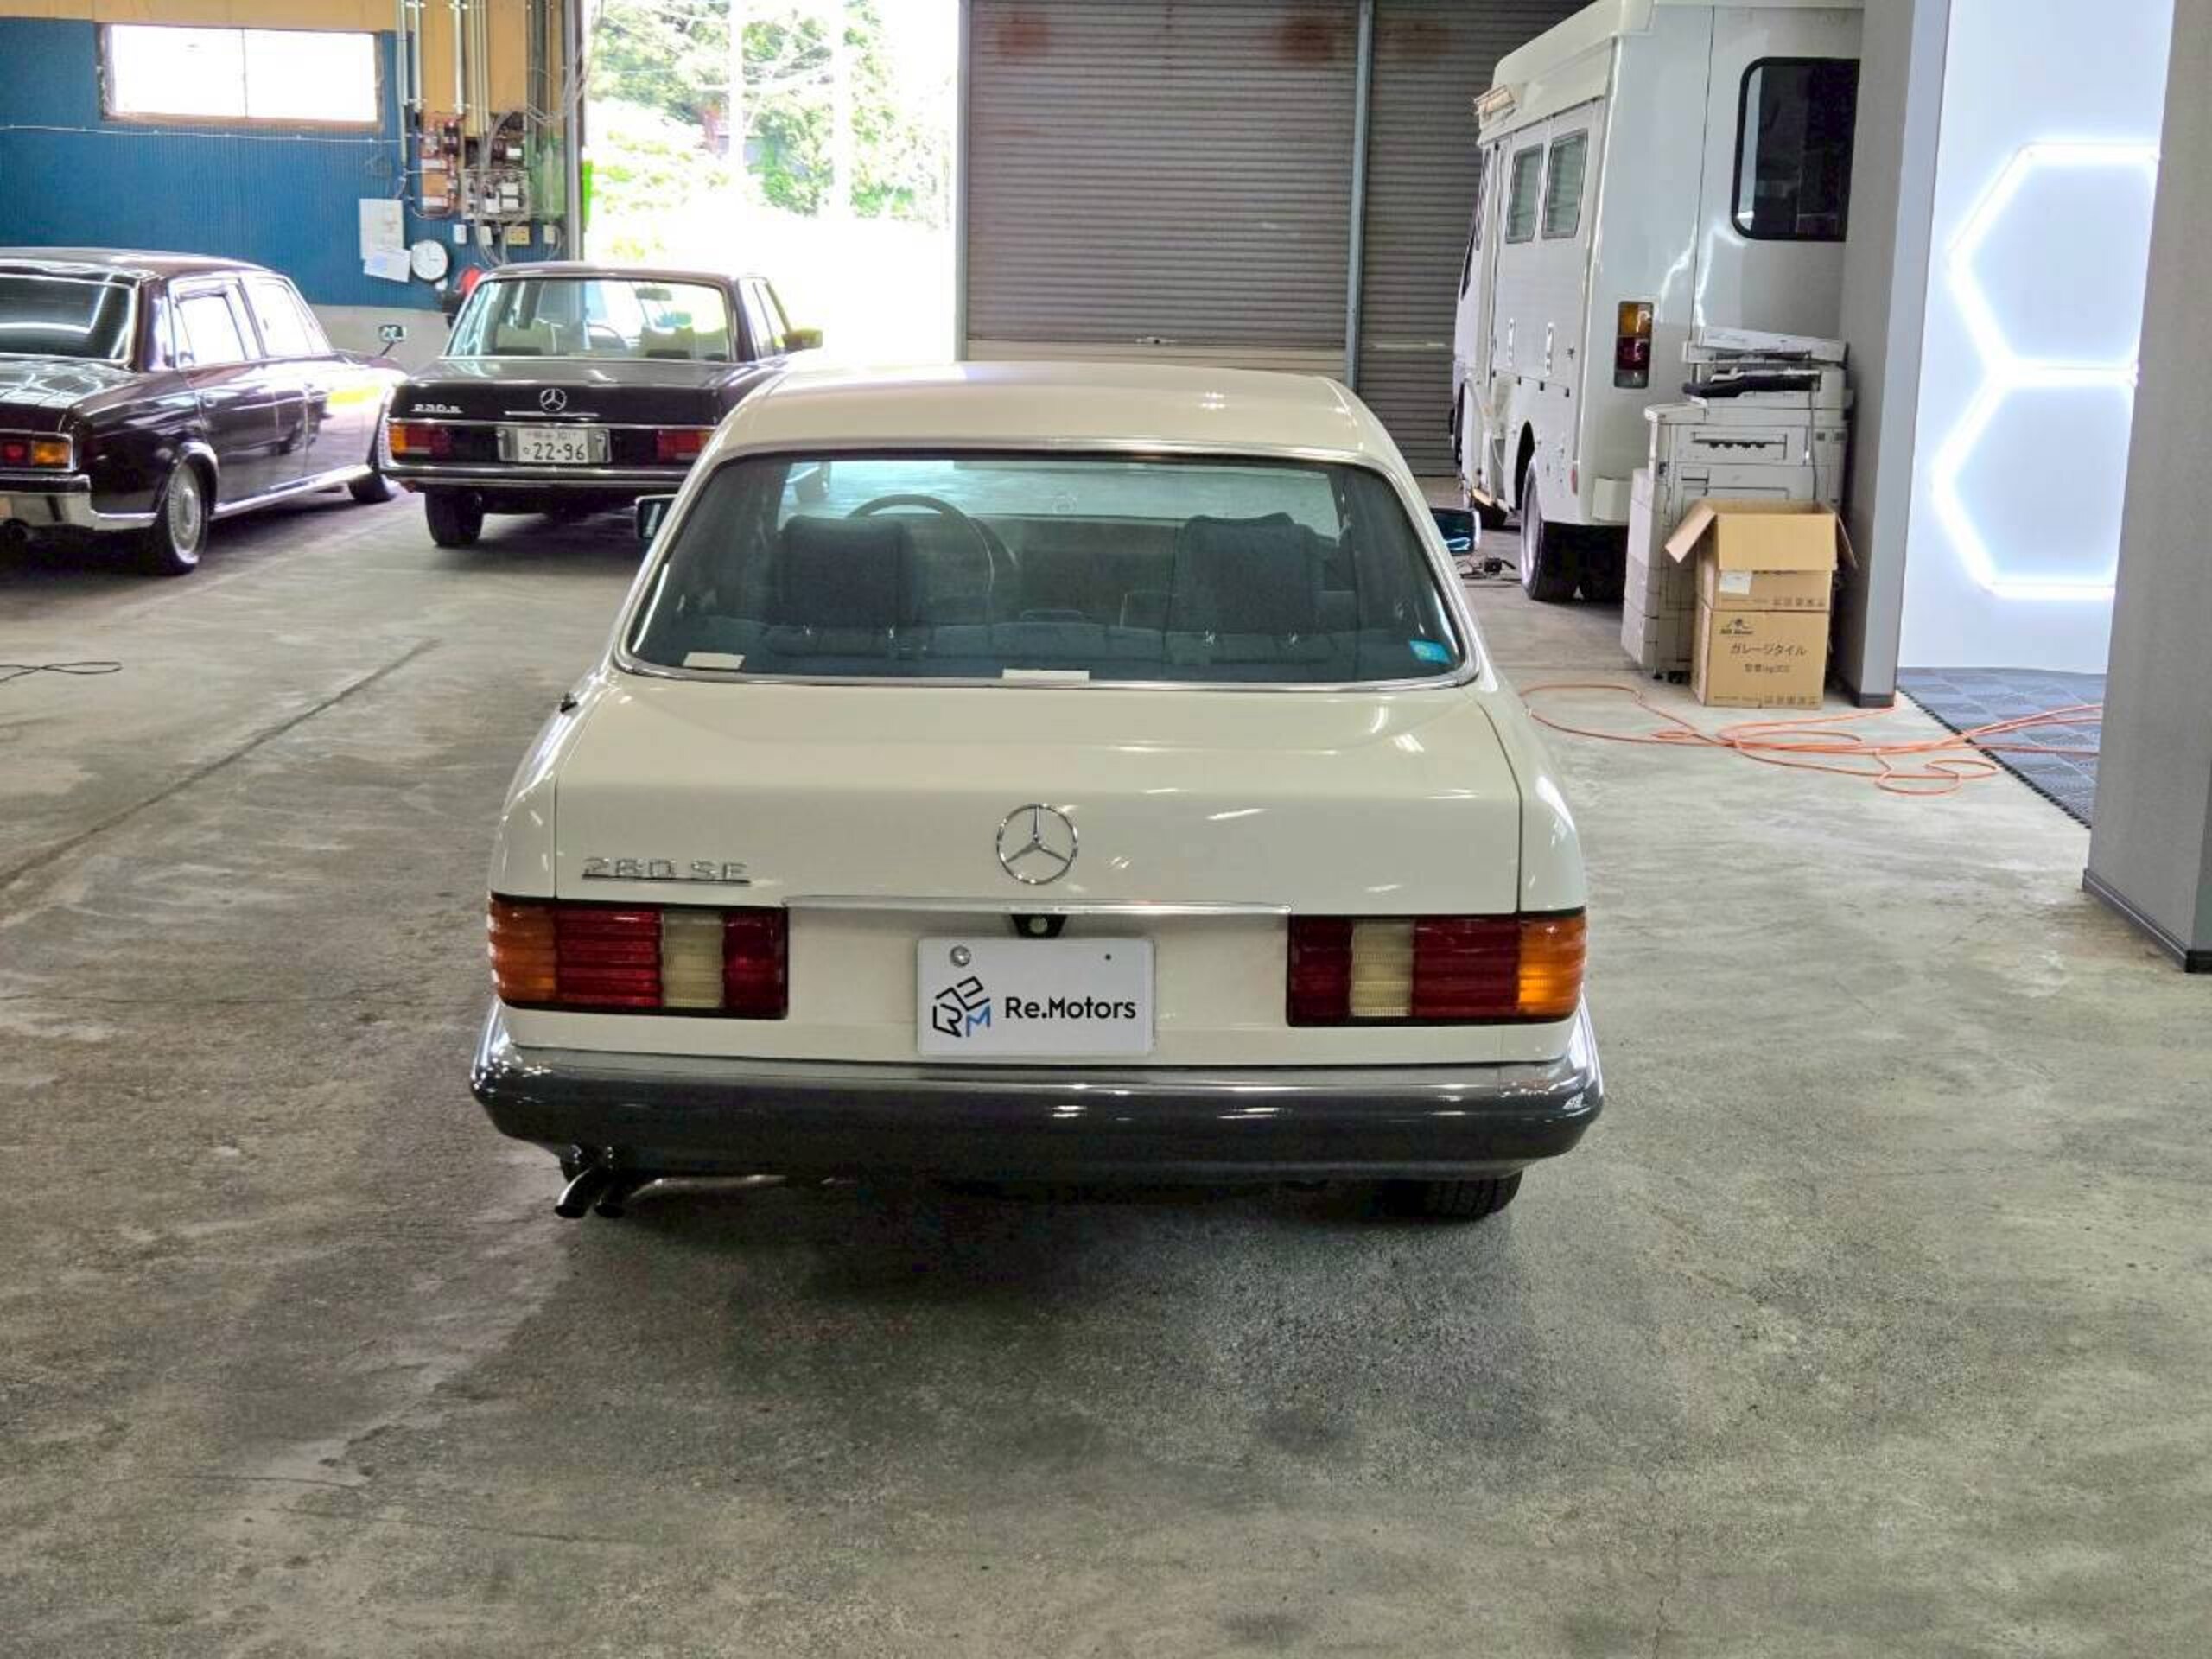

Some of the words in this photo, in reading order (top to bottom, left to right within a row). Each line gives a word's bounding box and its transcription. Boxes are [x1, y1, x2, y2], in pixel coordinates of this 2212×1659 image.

[1730, 642, 1808, 657] ガレージタイル
[582, 857, 677, 878] 280
[690, 860, 748, 882] SE
[1005, 996, 1136, 1019] Re.Motors
